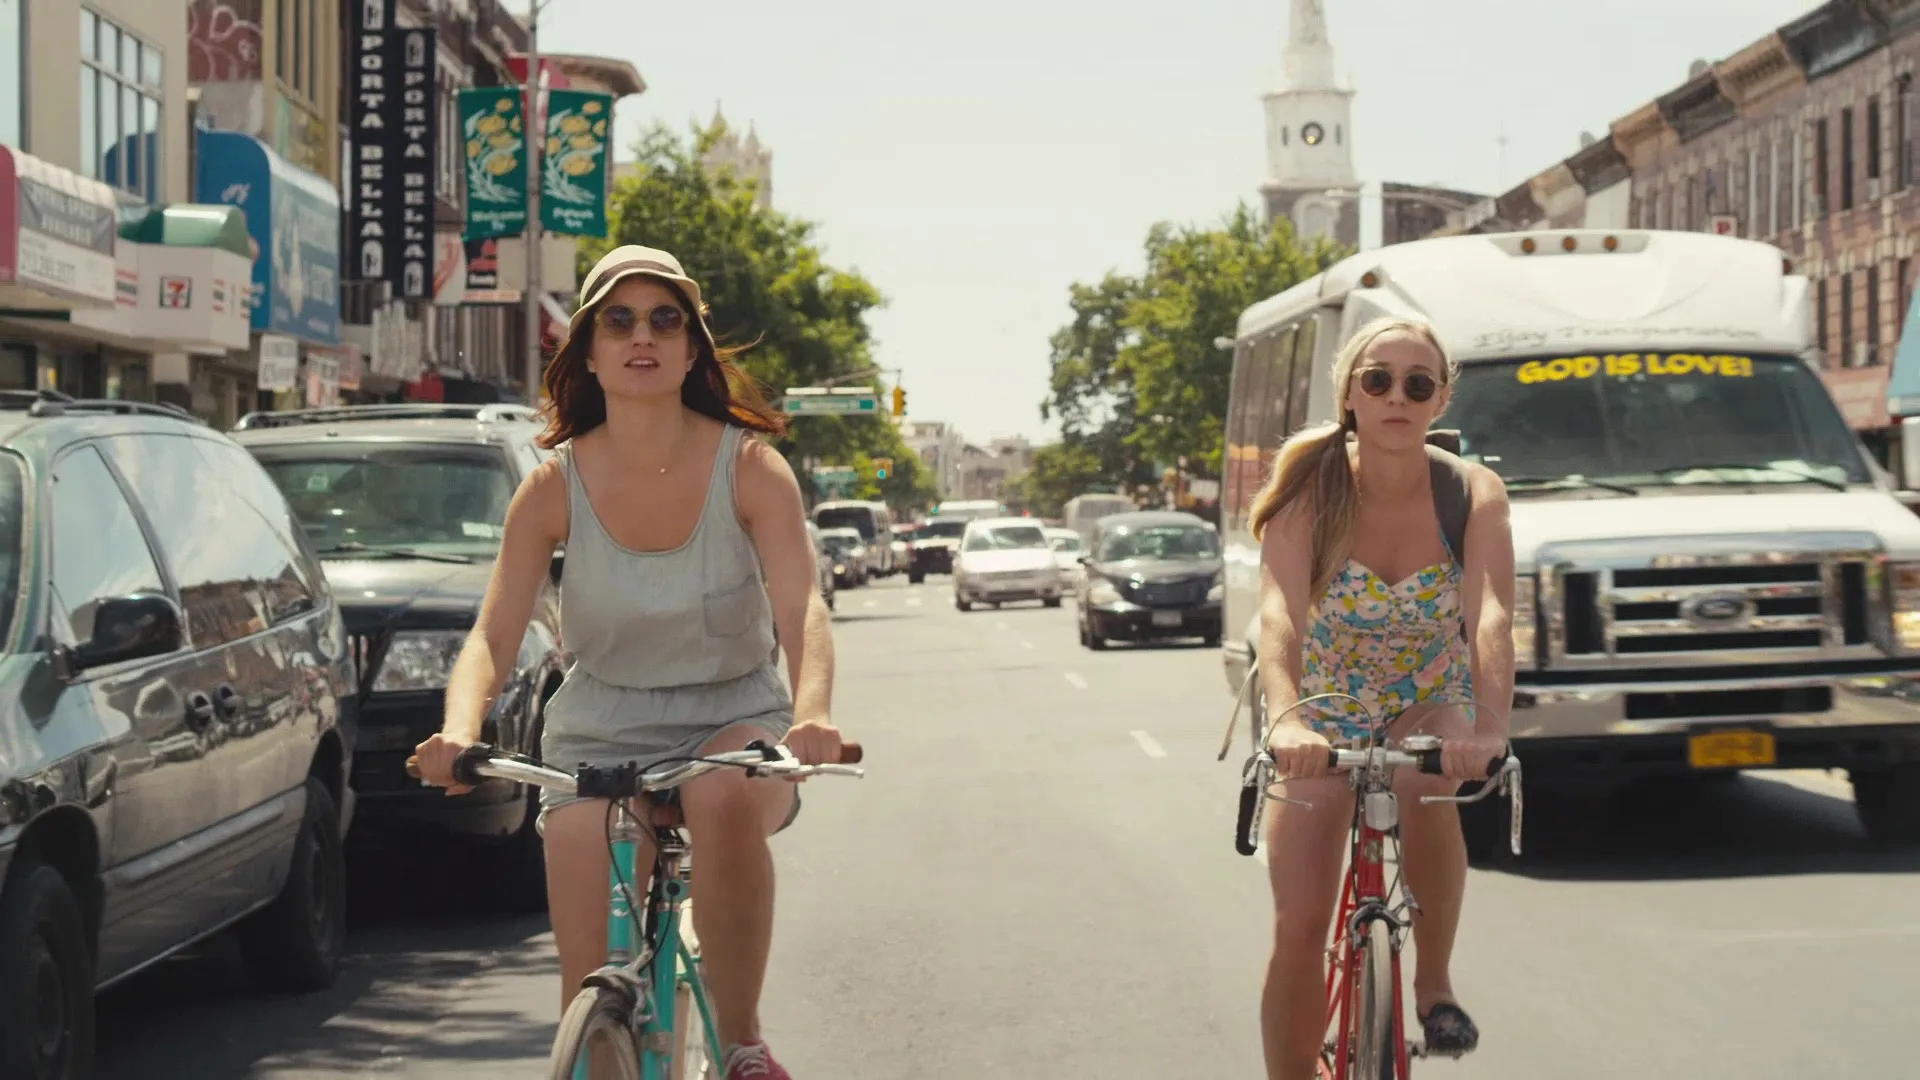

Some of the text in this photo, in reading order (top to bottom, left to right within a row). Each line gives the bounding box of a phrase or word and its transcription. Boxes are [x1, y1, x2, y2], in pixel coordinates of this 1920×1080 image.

[360, 34, 385, 237] PORTA BELLA
[403, 71, 427, 259] PORTA BELLA
[1516, 353, 1754, 384] GOD IS LOVE!
